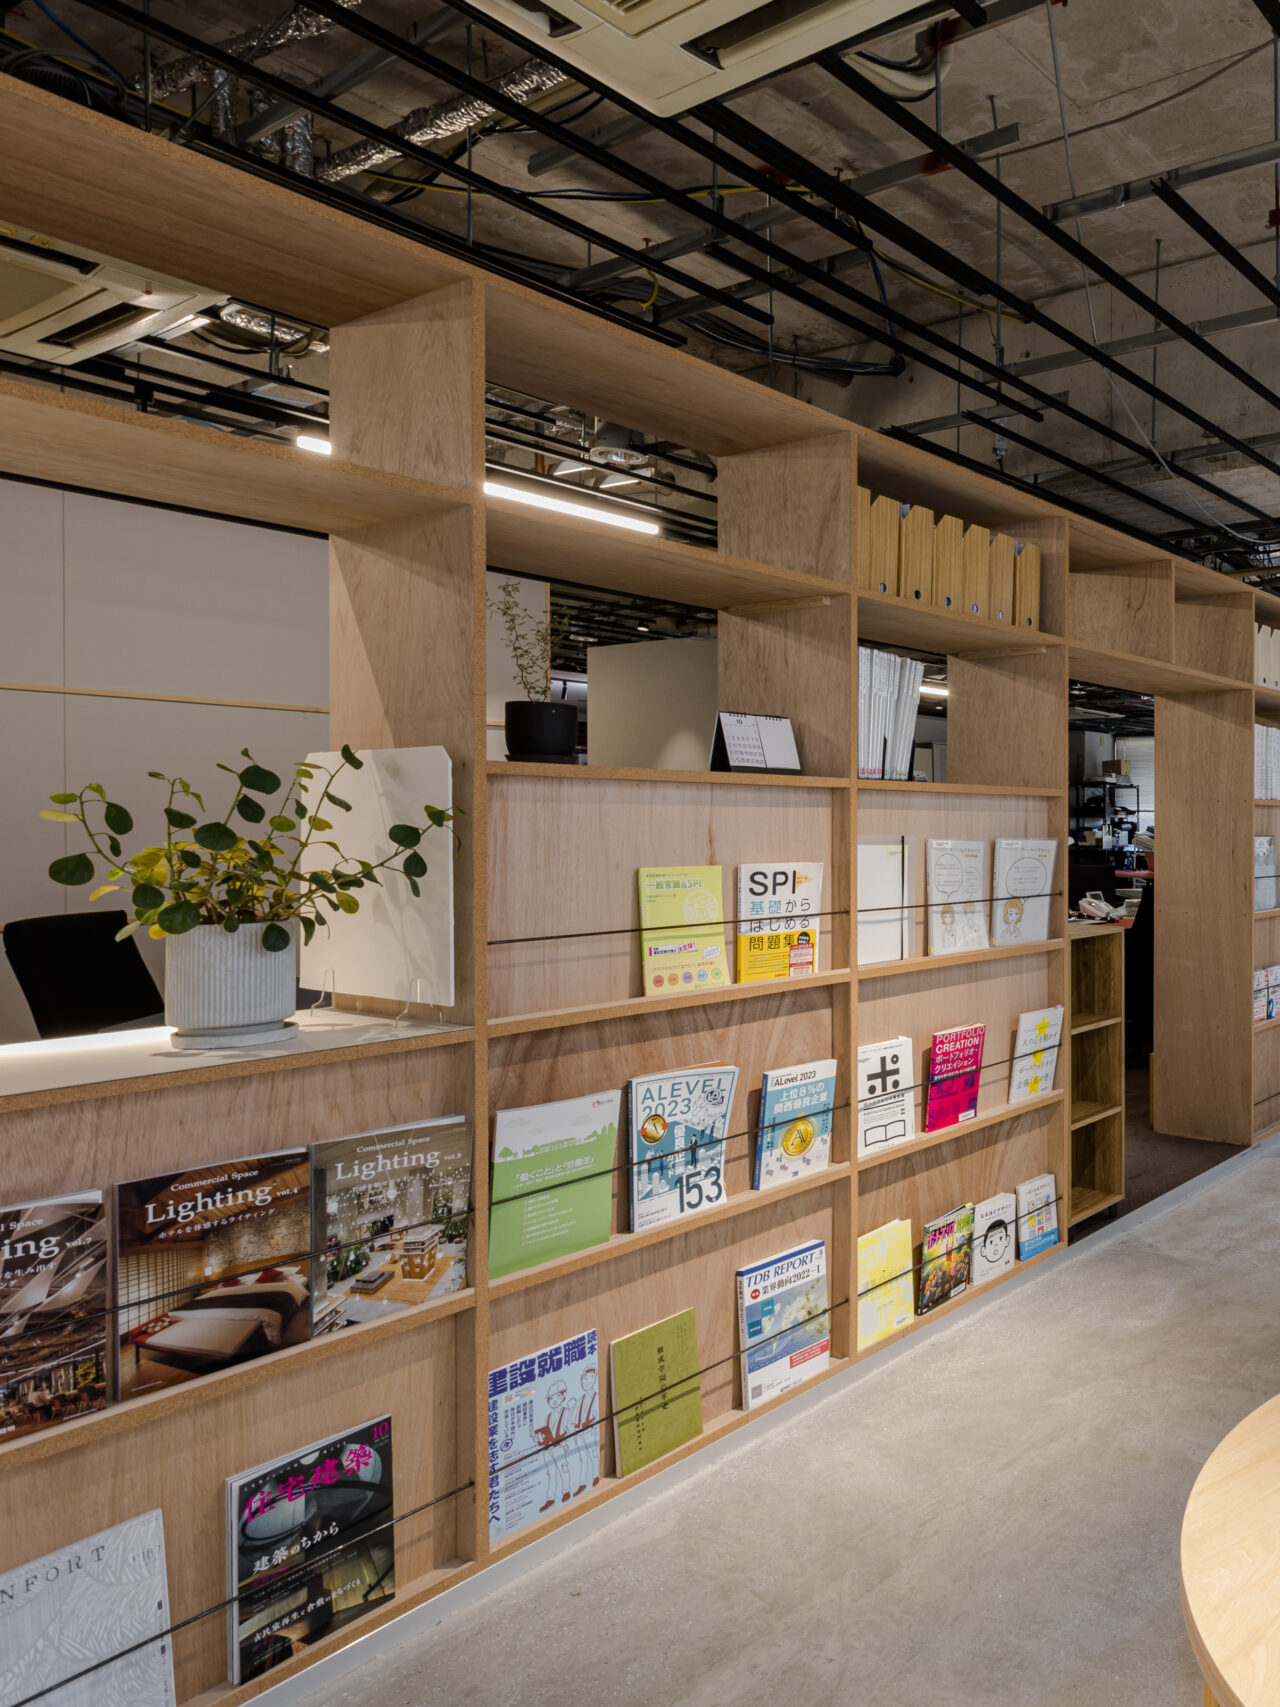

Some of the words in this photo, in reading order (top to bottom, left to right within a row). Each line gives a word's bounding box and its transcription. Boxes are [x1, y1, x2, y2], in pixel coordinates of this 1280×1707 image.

[748, 869, 797, 897] SPI
[749, 898, 811, 916] 基礎から
[749, 916, 810, 933] はじめる
[749, 934, 795, 952] 問題集
[936, 1026, 985, 1044] PORTFOLIO
[935, 1037, 980, 1054] CREATION
[934, 1057, 974, 1074] クリエイション
[773, 1074, 799, 1087] ALevel
[799, 1070, 817, 1082] 2023
[641, 1078, 727, 1105] ALEVEL
[642, 1097, 692, 1120] 2023
[357, 1139, 405, 1154] Commercial
[407, 1136, 431, 1146] Space
[335, 1151, 441, 1181] Lighting
[170, 1173, 228, 1193] Commercial
[231, 1169, 259, 1182] Space
[674, 1166, 723, 1214] 153
[145, 1186, 273, 1224] Lighting
[276, 1187, 299, 1198] vol.4
[9, 1218, 44, 1231] Space
[65, 1237, 93, 1248] vol.7
[0, 1262, 57, 1280] を生み出す
[745, 1269, 771, 1288] TDB
[773, 1251, 816, 1278] REPORT
[488, 1335, 587, 1399] 建設就職
[372, 1421, 390, 1441] 10
[252, 1521, 340, 1576] 建築のちから
[0, 1545, 107, 1604] NFORT
